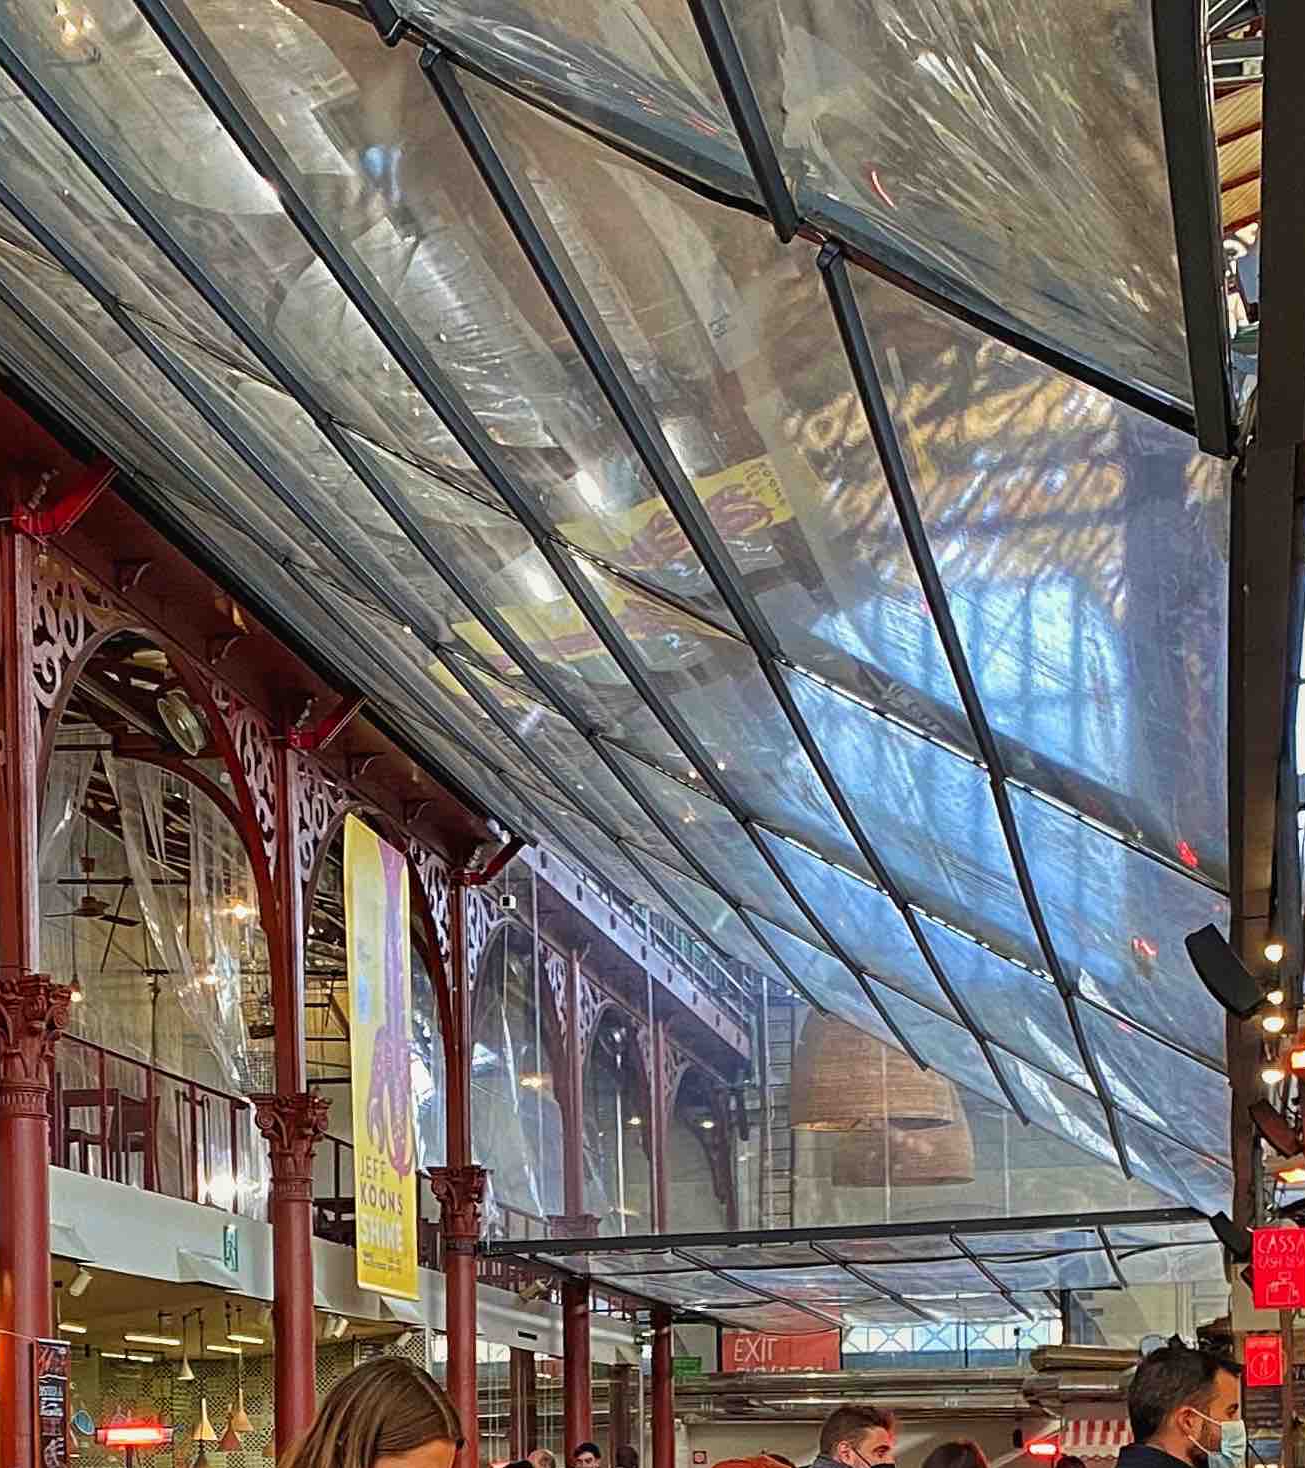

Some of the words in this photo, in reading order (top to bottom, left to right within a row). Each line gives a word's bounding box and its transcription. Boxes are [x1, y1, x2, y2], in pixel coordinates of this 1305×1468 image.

[360, 1154, 387, 1180] JEFF
[359, 1181, 404, 1216] KOONS
[734, 1336, 778, 1362] EXIT
